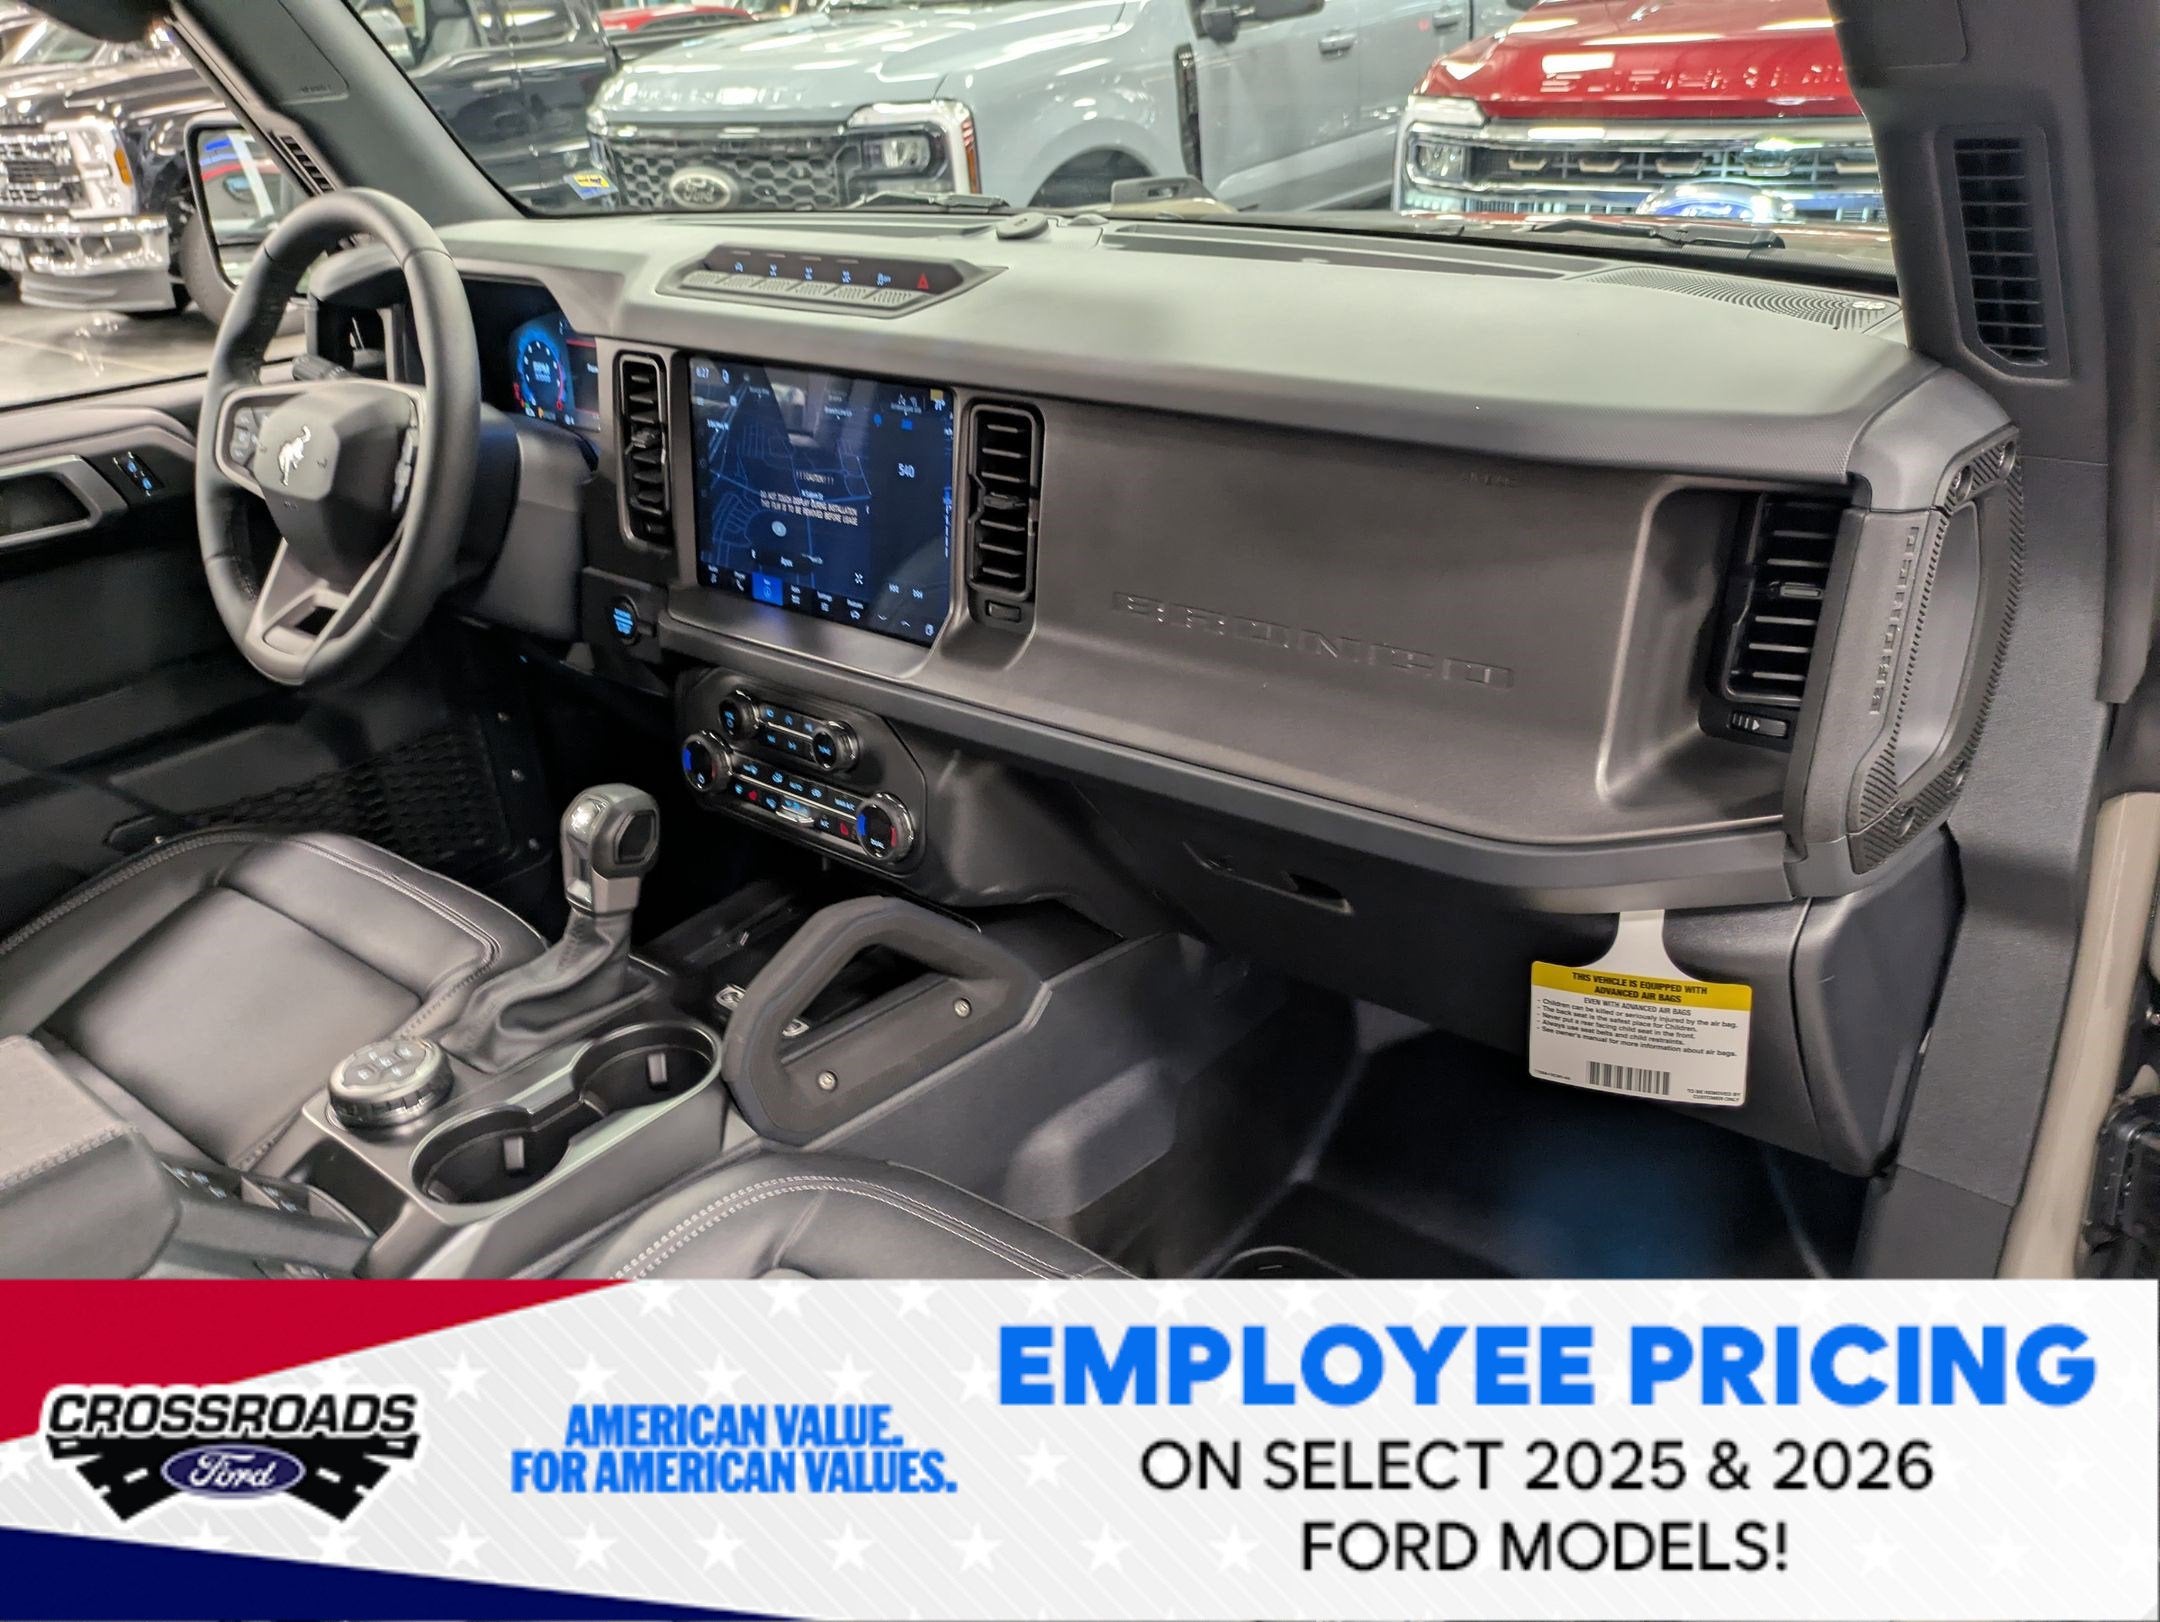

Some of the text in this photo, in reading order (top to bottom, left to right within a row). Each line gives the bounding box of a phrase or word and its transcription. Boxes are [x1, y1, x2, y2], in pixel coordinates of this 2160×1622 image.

[1113, 591, 1514, 692] BRONCO
[1572, 972, 1708, 995] THIS VEHICLE IS EQUIPPED WITH
[1594, 986, 1682, 1003] ADVANCED AIR BAGS
[1543, 998, 1570, 1008] Children
[1625, 1013, 1657, 1022] seriously
[1659, 1016, 1684, 1024] injured
[1686, 1018, 1695, 1026] by
[1722, 1021, 1738, 1029] bag.
[1584, 997, 1600, 1006] EVEN
[1602, 1000, 1619, 1008] WITH
[1621, 1003, 1657, 1013] ADVANCED
[1672, 1008, 1691, 1016] BAGS
[1542, 1012, 1561, 1020] Never
[1596, 1022, 1617, 1031] facing
[1542, 1019, 1565, 1029] Always
[1648, 1037, 1684, 1045] restraints.
[1556, 1008, 1571, 1016] back
[1665, 1023, 1697, 1032] Children.
[1541, 1025, 1554, 1033] See
[1555, 1030, 1581, 1038] owner's
[1640, 1042, 1681, 1051] information
[1717, 1050, 1737, 1058] bags.
